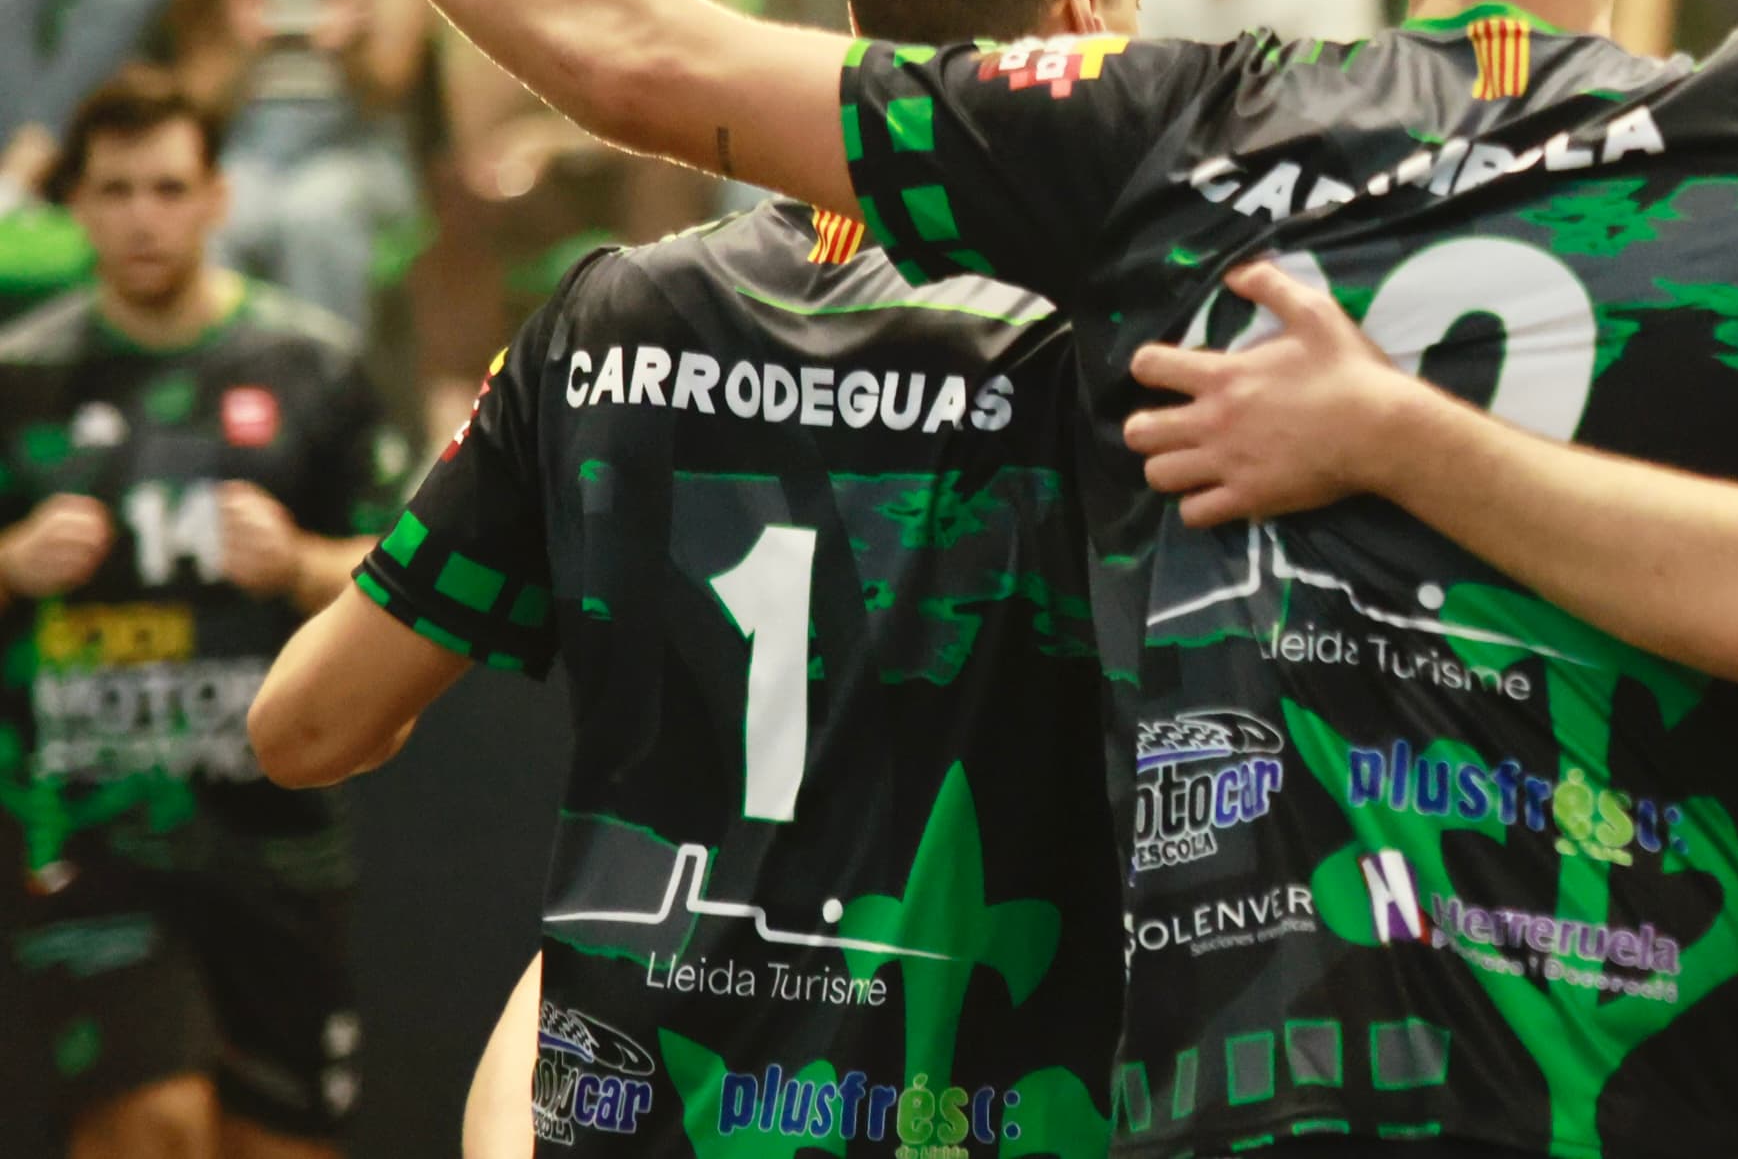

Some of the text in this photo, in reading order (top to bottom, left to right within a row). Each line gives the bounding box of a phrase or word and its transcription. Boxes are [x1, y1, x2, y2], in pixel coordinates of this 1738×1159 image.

[565, 345, 1015, 433] CARRODEGUAS
[707, 524, 817, 822] 1
[1126, 884, 1314, 953] OLENVER
[646, 950, 888, 1007] Lleida Turisme
